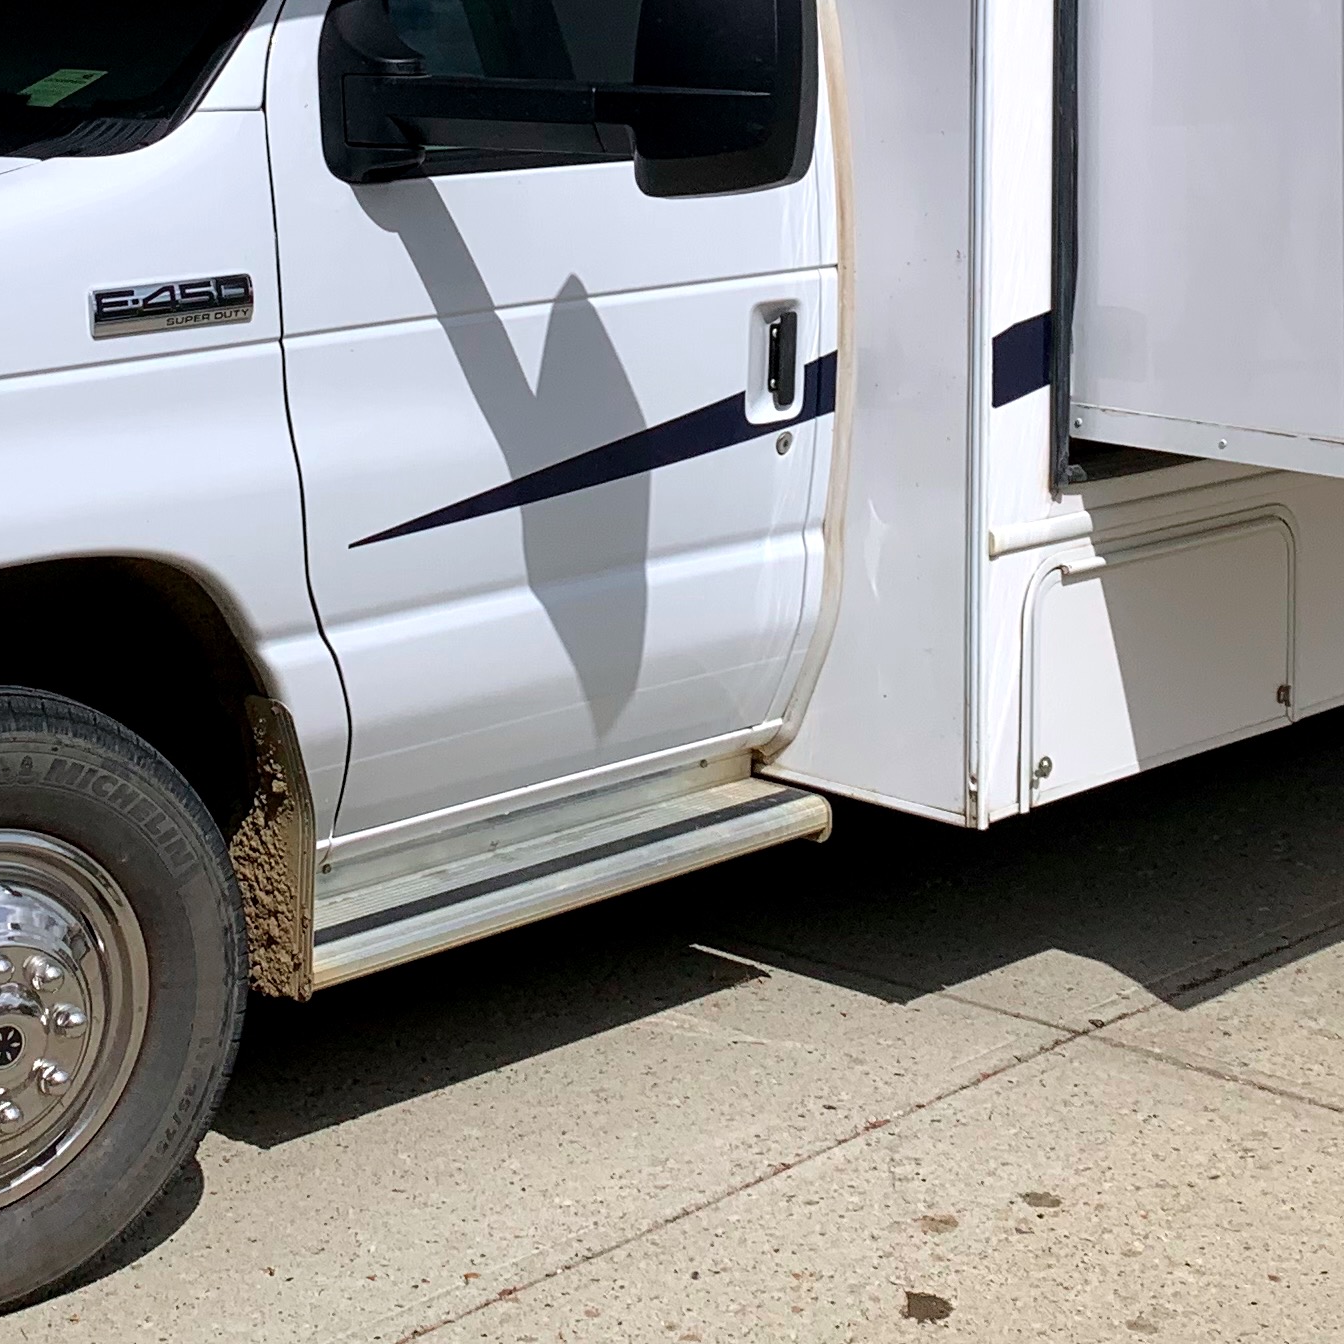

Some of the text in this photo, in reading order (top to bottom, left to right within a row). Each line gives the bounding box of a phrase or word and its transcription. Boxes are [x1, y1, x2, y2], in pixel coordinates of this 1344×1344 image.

[166, 308, 249, 327] SUPER DUTY
[43, 756, 195, 868] MICHELIN
